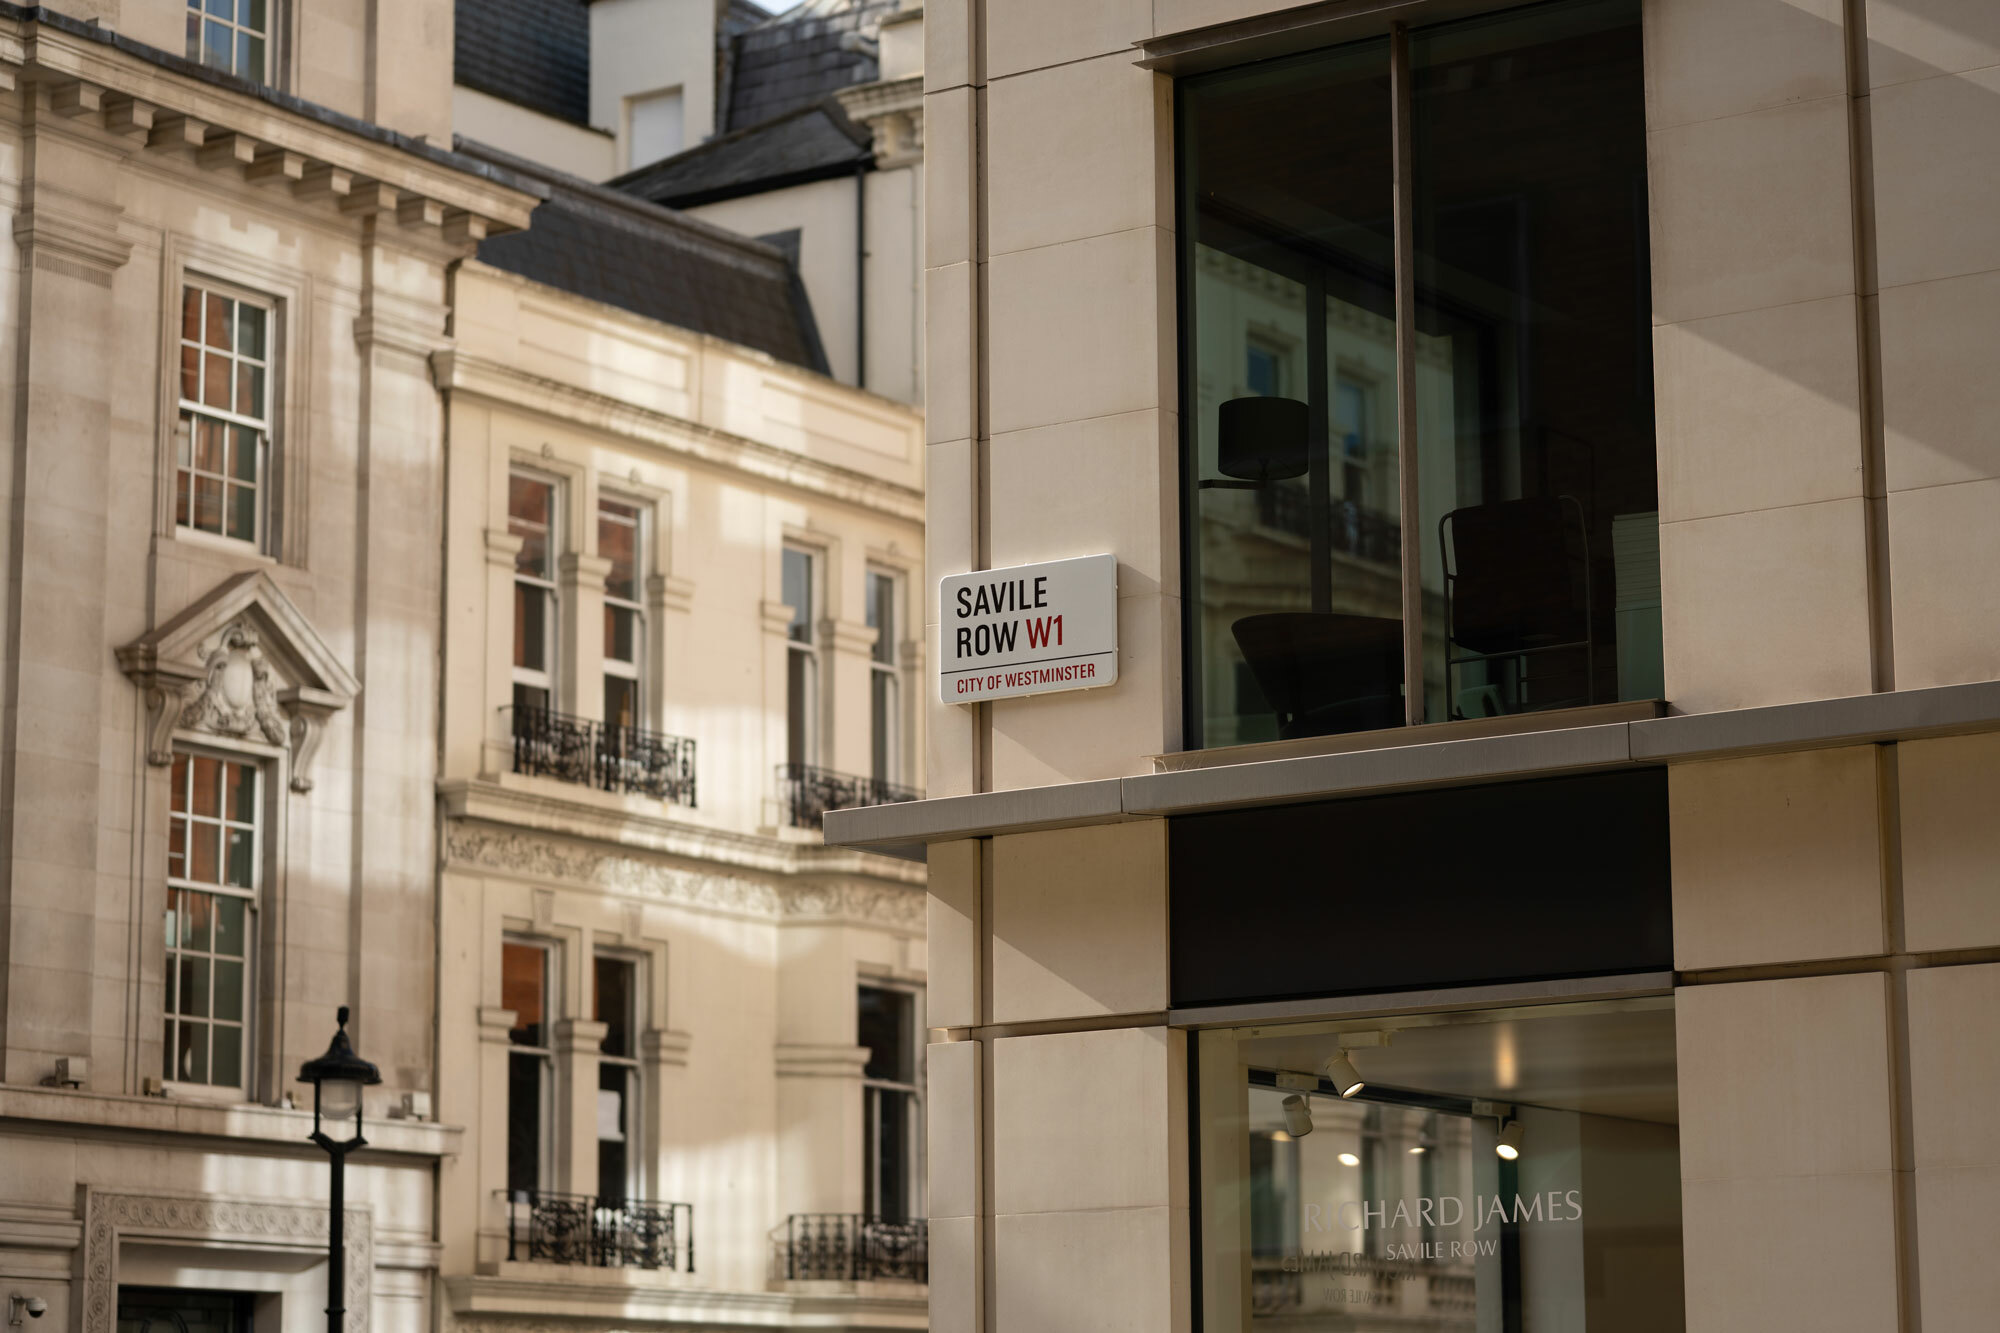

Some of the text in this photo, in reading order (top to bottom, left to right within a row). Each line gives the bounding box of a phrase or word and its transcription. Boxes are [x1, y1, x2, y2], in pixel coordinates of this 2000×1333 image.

[956, 576, 1048, 619] SAVILE
[956, 614, 1063, 658] ROW W1
[957, 663, 1096, 694] CITY OF WESTMINSTER
[1303, 1189, 1583, 1233] RICHARD JAMES
[1386, 1239, 1497, 1261] SAVILE ROW
